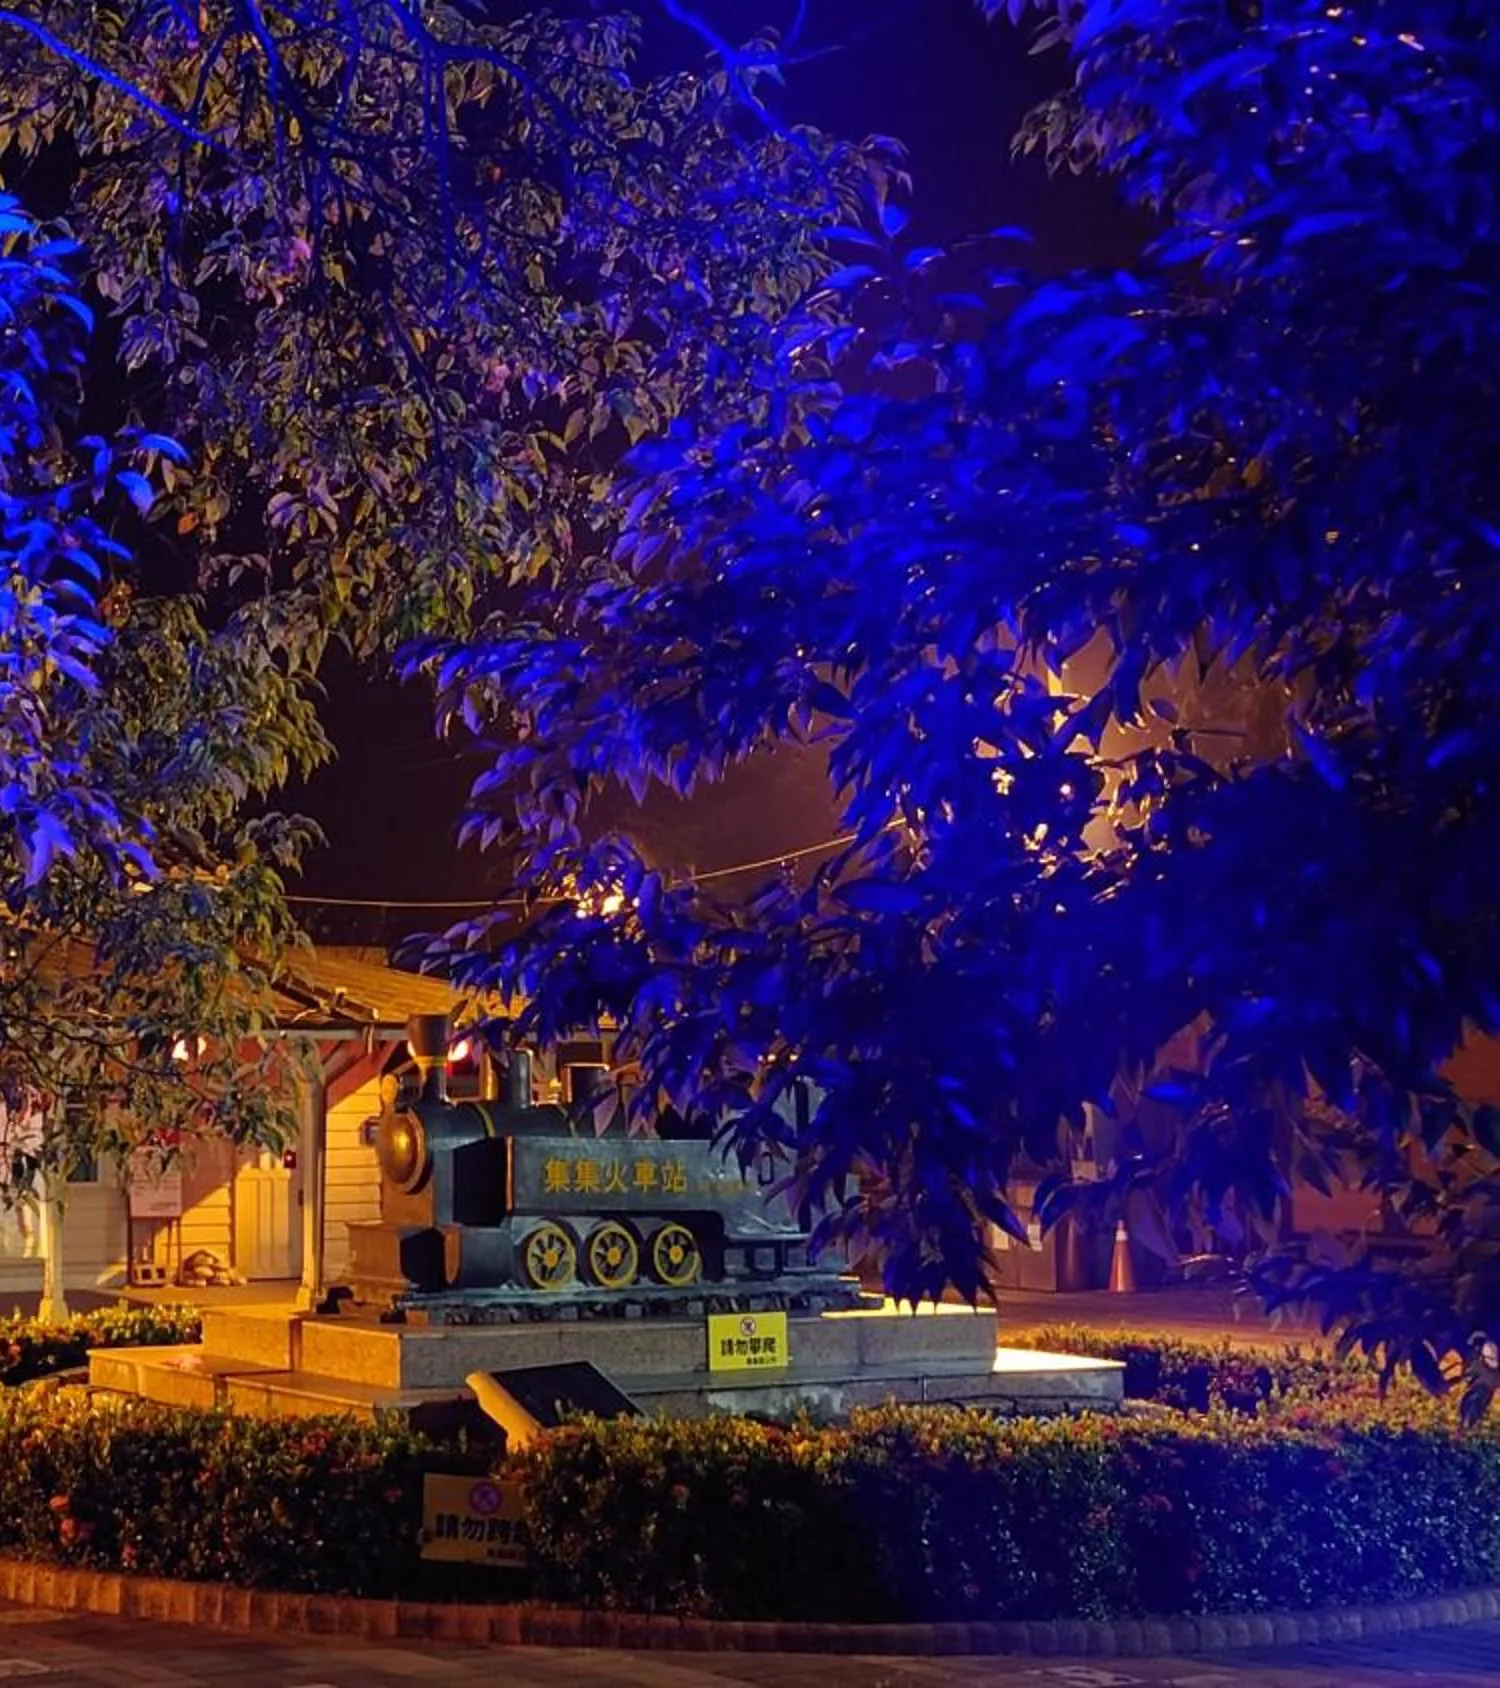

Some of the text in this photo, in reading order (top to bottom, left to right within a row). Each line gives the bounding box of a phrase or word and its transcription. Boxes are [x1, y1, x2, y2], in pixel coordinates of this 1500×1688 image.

[543, 1155, 688, 1193] 集集火車站
